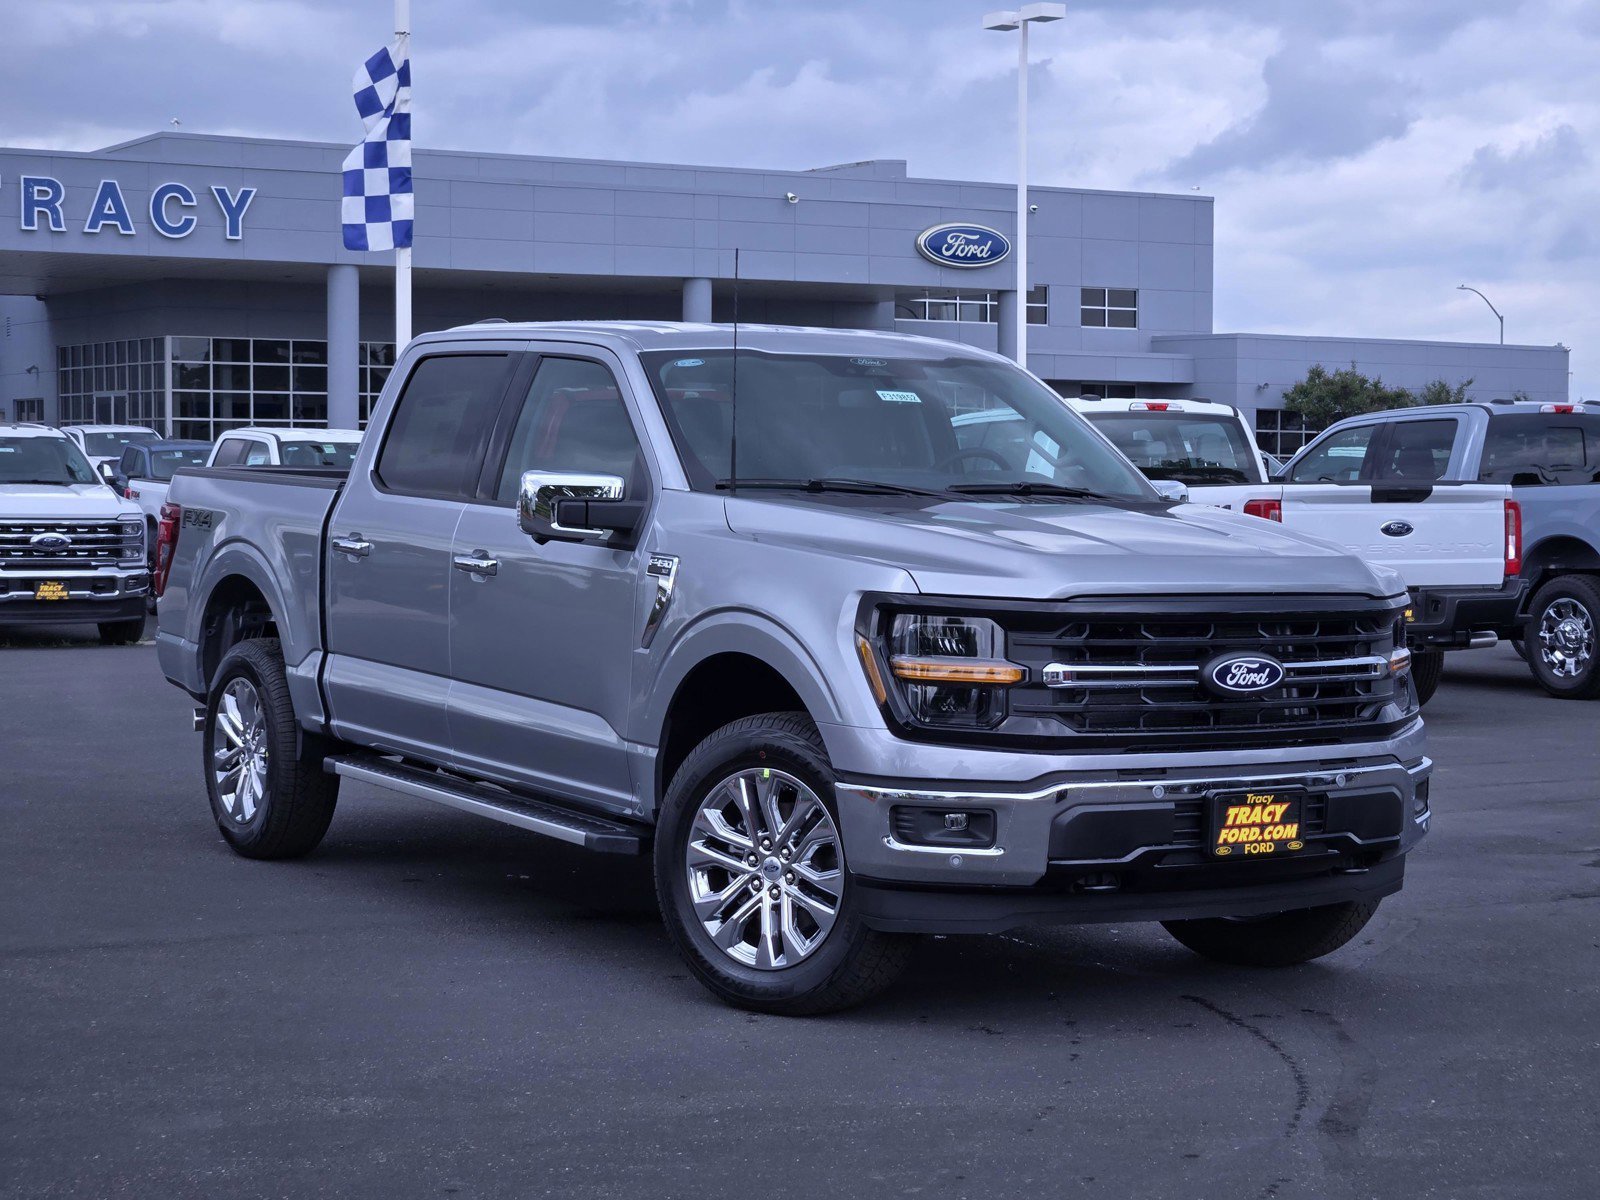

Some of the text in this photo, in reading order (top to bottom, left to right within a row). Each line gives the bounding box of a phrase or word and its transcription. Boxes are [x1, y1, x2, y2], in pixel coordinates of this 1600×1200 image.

[0, 174, 257, 240] RACY
[941, 232, 993, 258] Ford
[182, 509, 213, 529] FX4
[1345, 542, 1494, 555] PER DUTY
[1226, 662, 1270, 685] Ford
[1246, 793, 1275, 804] Tracy
[1225, 802, 1291, 827] TRACY
[1217, 823, 1299, 844] FORD.COM
[1244, 842, 1275, 854] FORD
